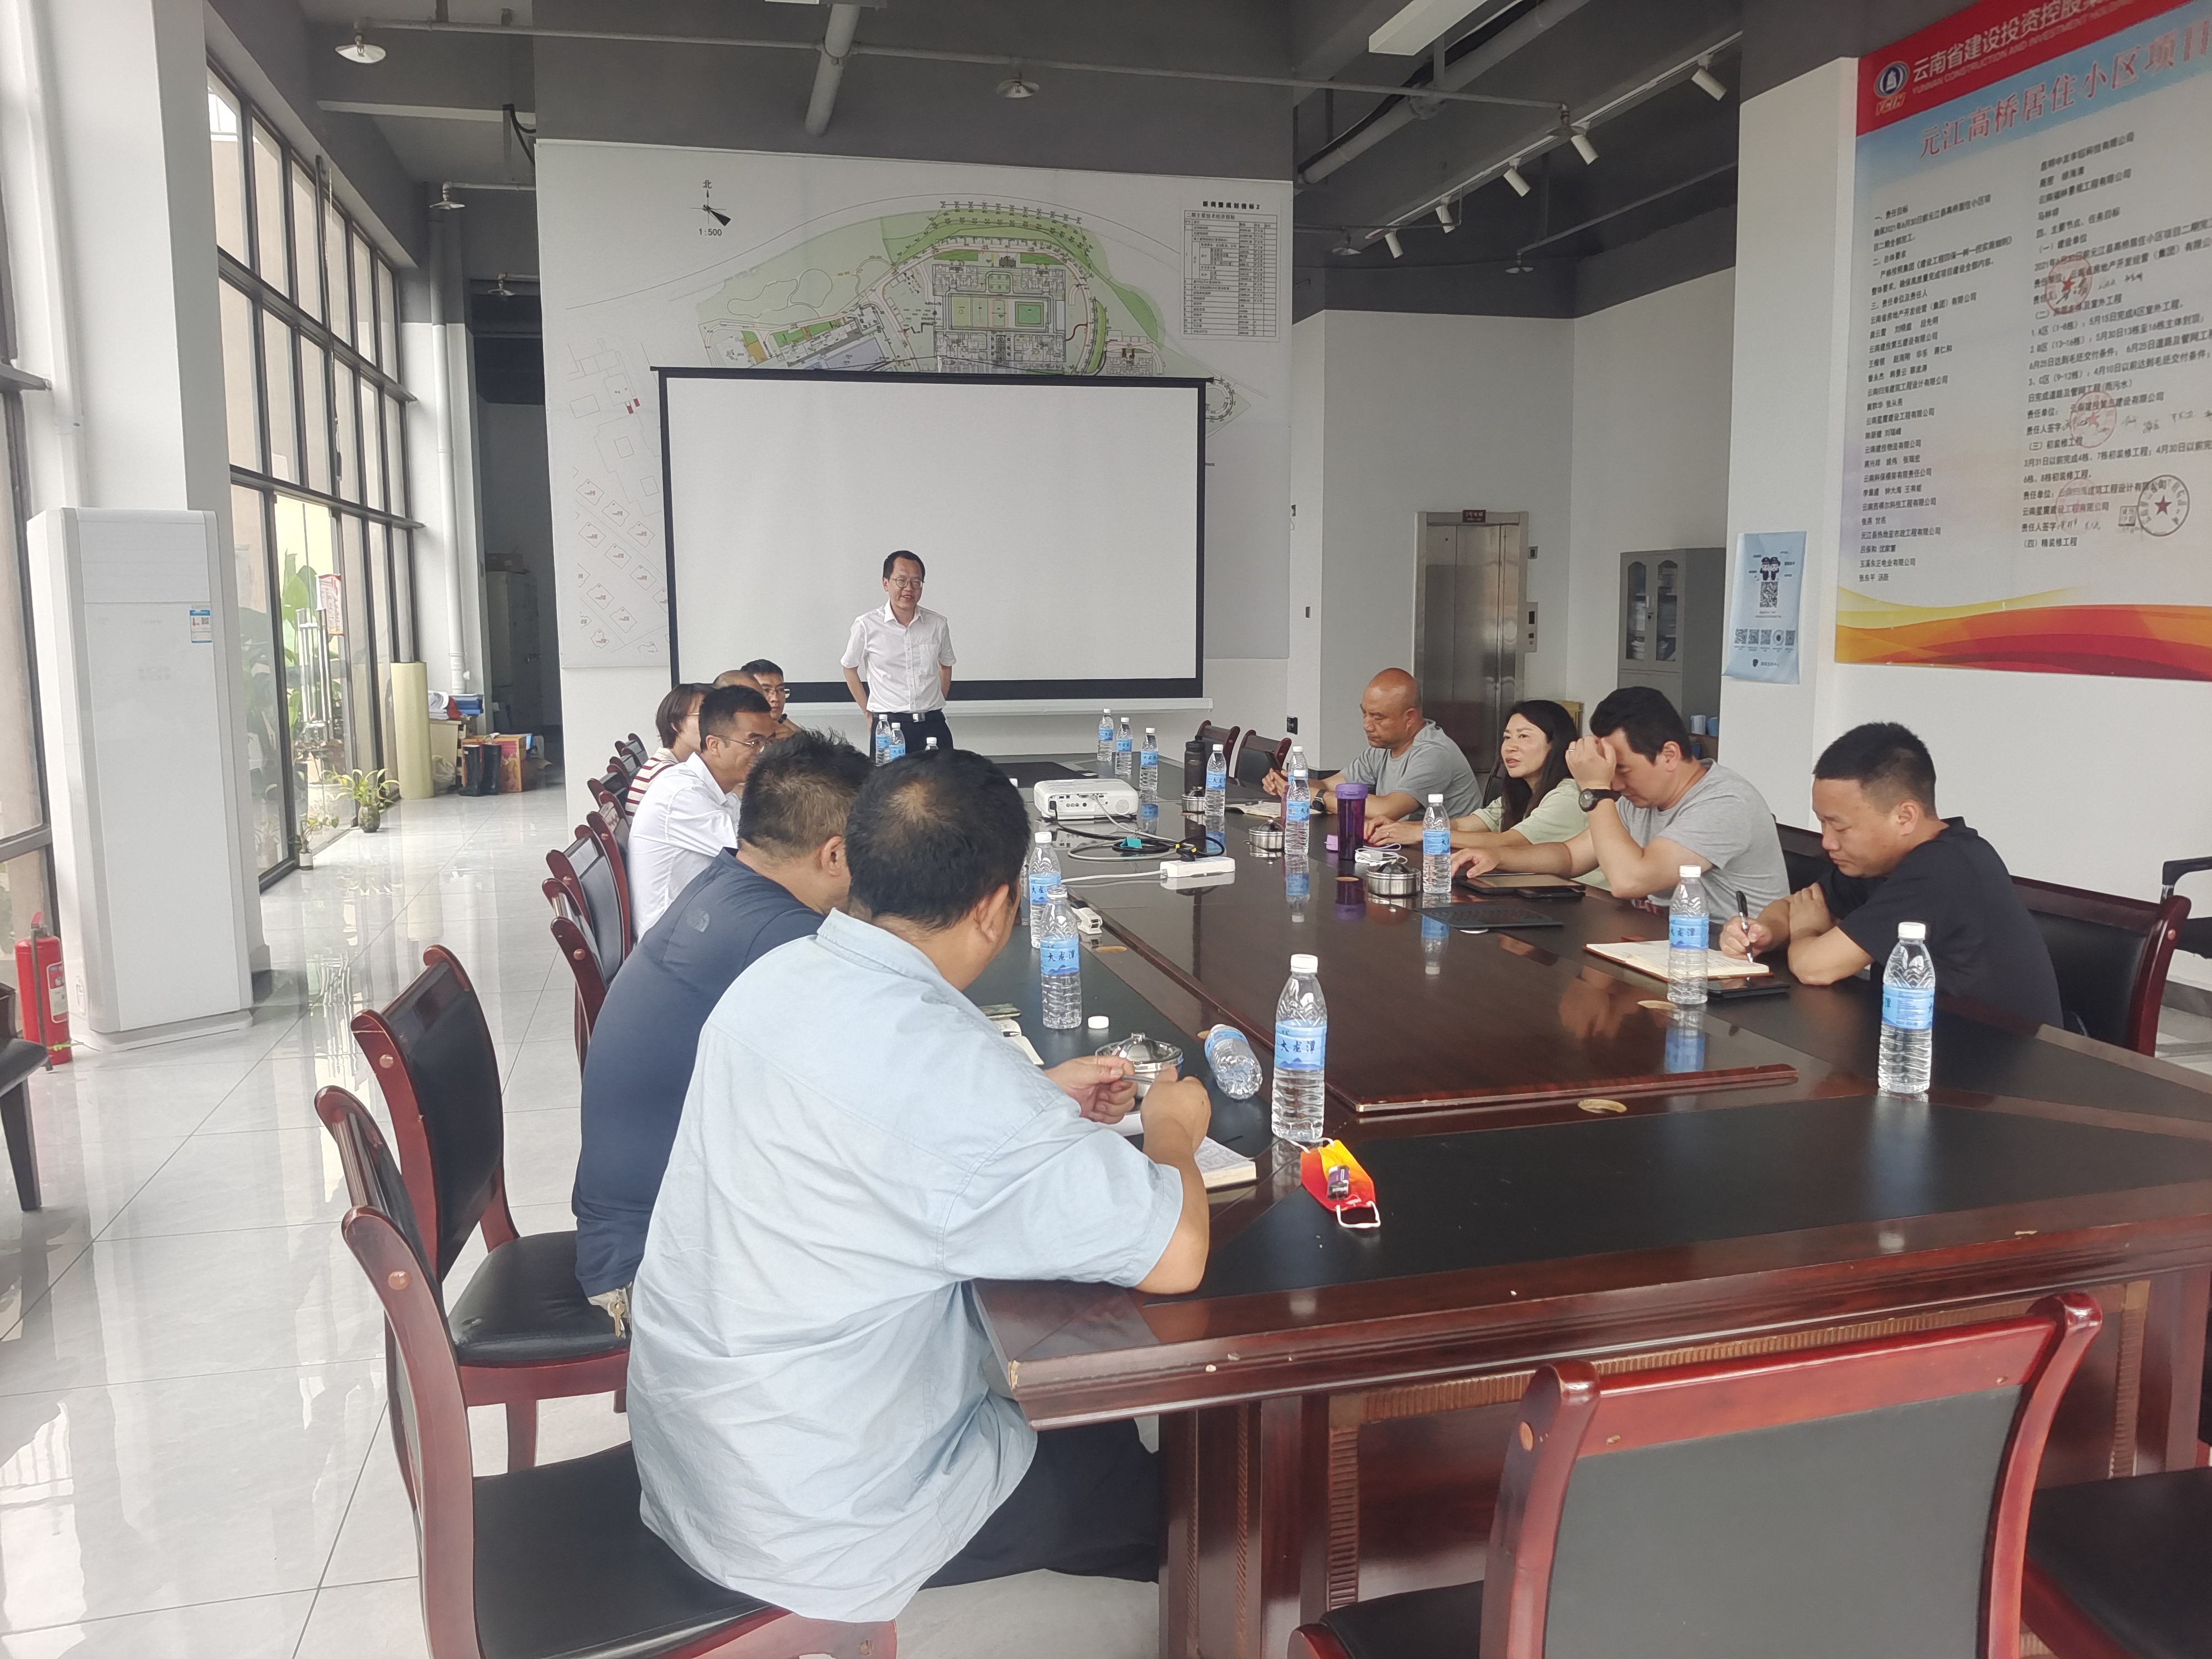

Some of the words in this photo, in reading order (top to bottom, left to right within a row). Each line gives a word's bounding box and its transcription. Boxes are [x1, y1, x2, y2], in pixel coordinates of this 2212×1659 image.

[1913, 0, 2099, 84] 云南省建设投资控股
[1919, 18, 2210, 160] 元江高桥居住小区项目
[702, 179, 712, 189] 北
[699, 228, 722, 236] 1:500
[1280, 1039, 1316, 1054] 大龙潭
